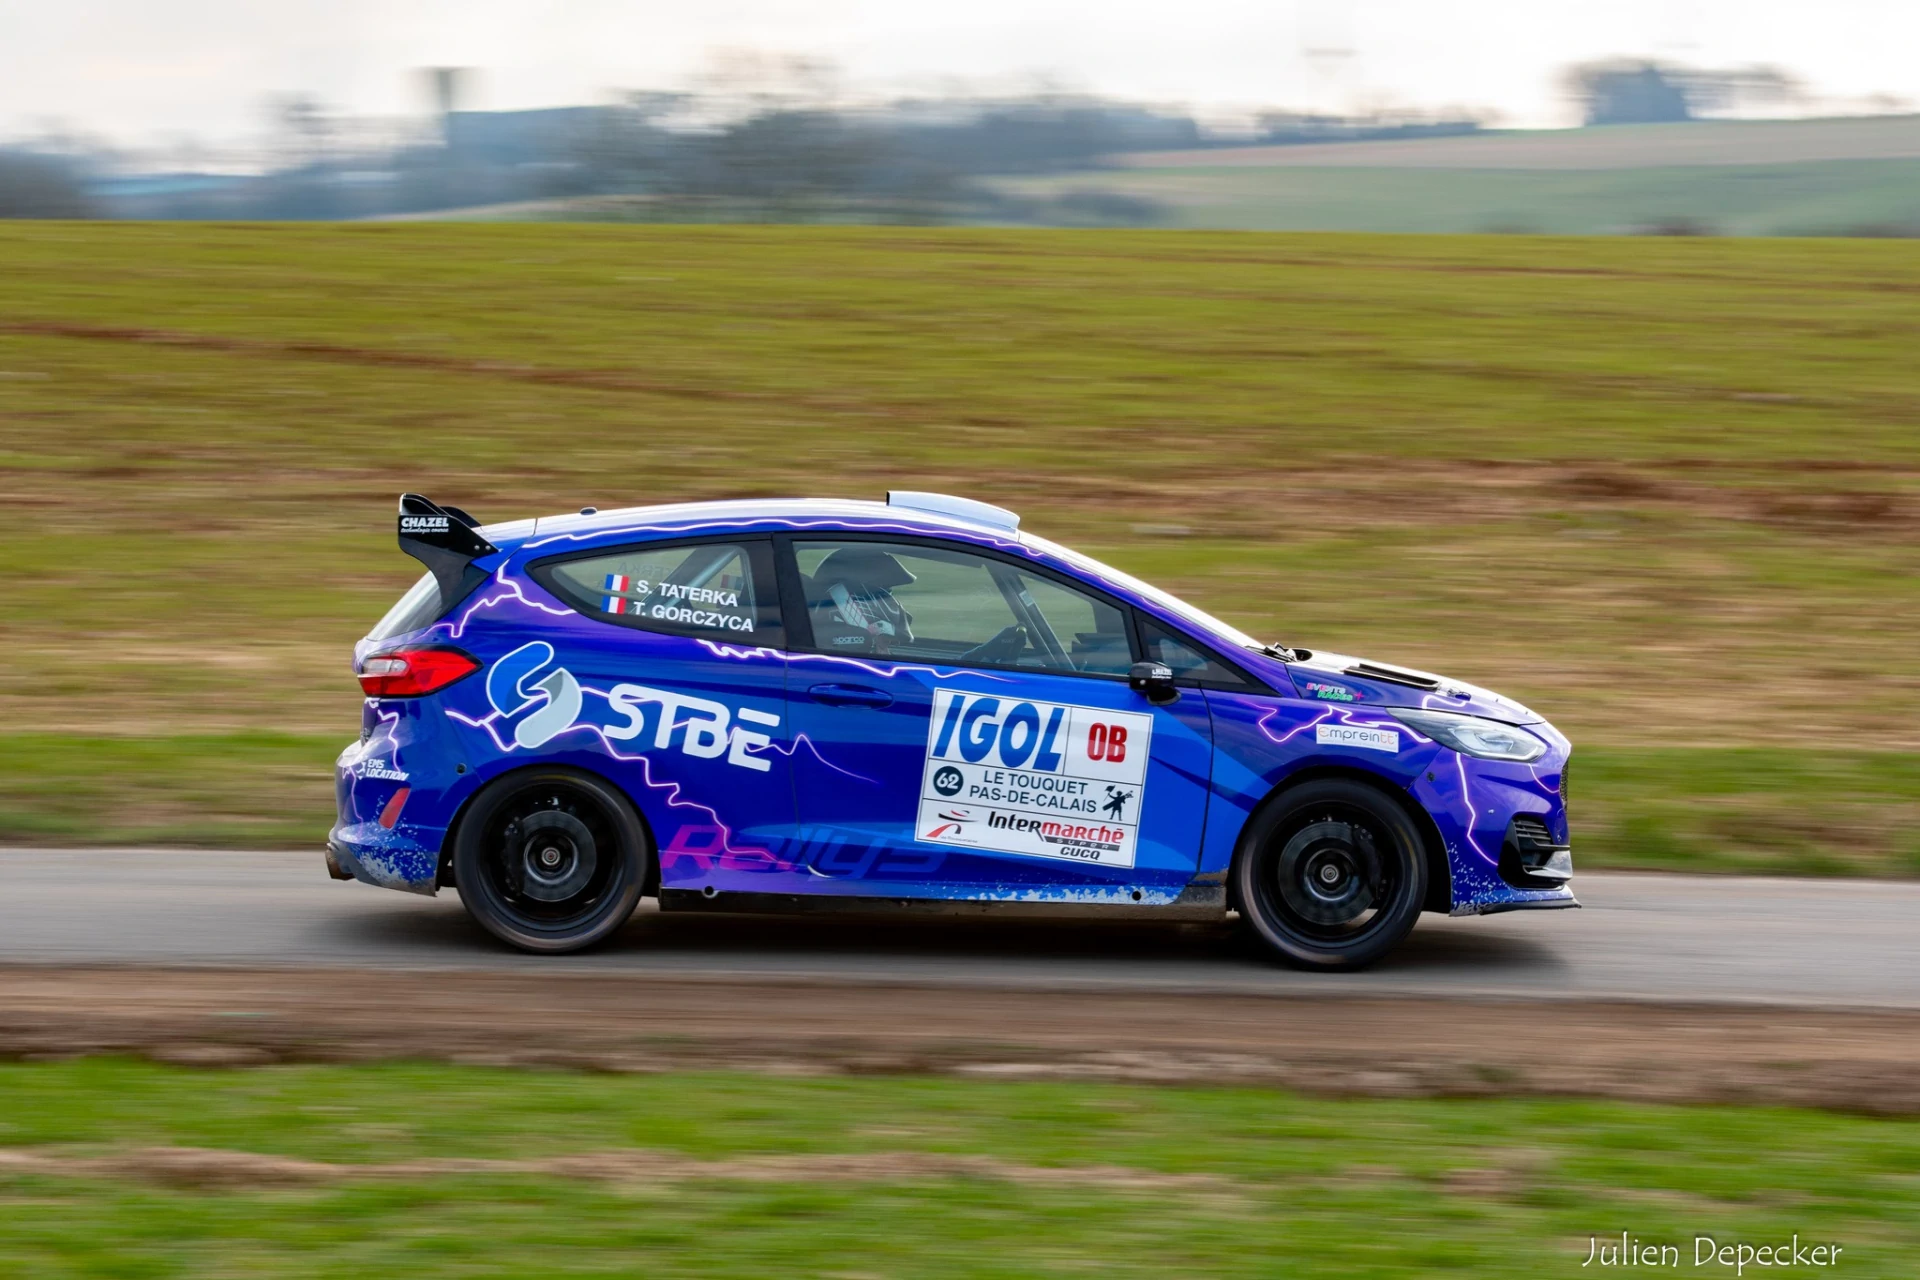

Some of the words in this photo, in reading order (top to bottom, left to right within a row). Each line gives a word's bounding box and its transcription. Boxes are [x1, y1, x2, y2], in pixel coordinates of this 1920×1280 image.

[402, 517, 449, 527] CHAZEL
[636, 580, 653, 595] S.
[658, 582, 739, 608] TATERKA
[633, 601, 647, 616] T.
[651, 604, 755, 633] GORCZYCA
[603, 683, 780, 772] STBE
[932, 695, 1065, 772] IGOL
[366, 768, 409, 781] LOCATION
[368, 758, 385, 768] EMS
[936, 772, 959, 790] 62
[984, 770, 1005, 785] LE
[1008, 773, 1088, 795] TOUQUET
[969, 785, 1097, 813] PAS-DE-CALAIS
[1060, 846, 1101, 861] CUCQ
